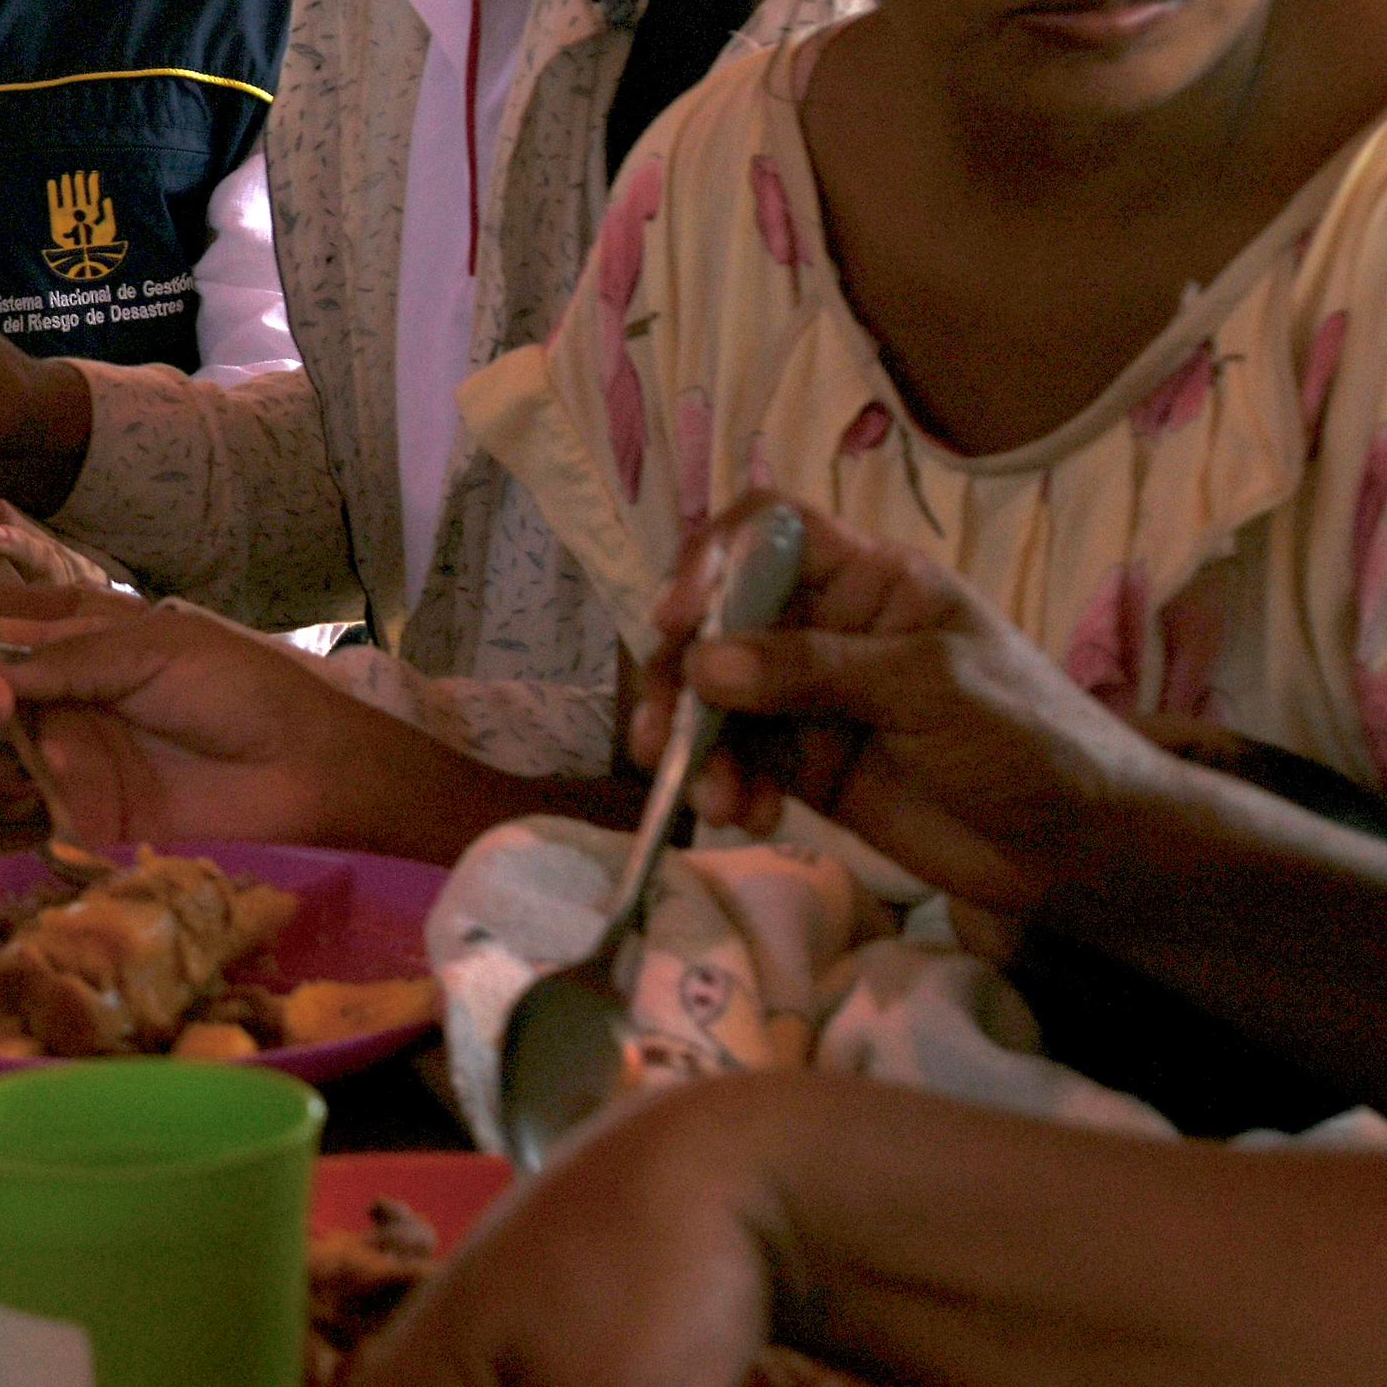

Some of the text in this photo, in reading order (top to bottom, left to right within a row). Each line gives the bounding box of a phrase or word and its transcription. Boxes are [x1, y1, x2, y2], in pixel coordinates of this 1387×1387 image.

[49, 285, 111, 308] Nacional
[116, 283, 135, 300] de
[143, 273, 195, 297] Gestión
[3, 299, 184, 333] del Riesgo de Desastres
